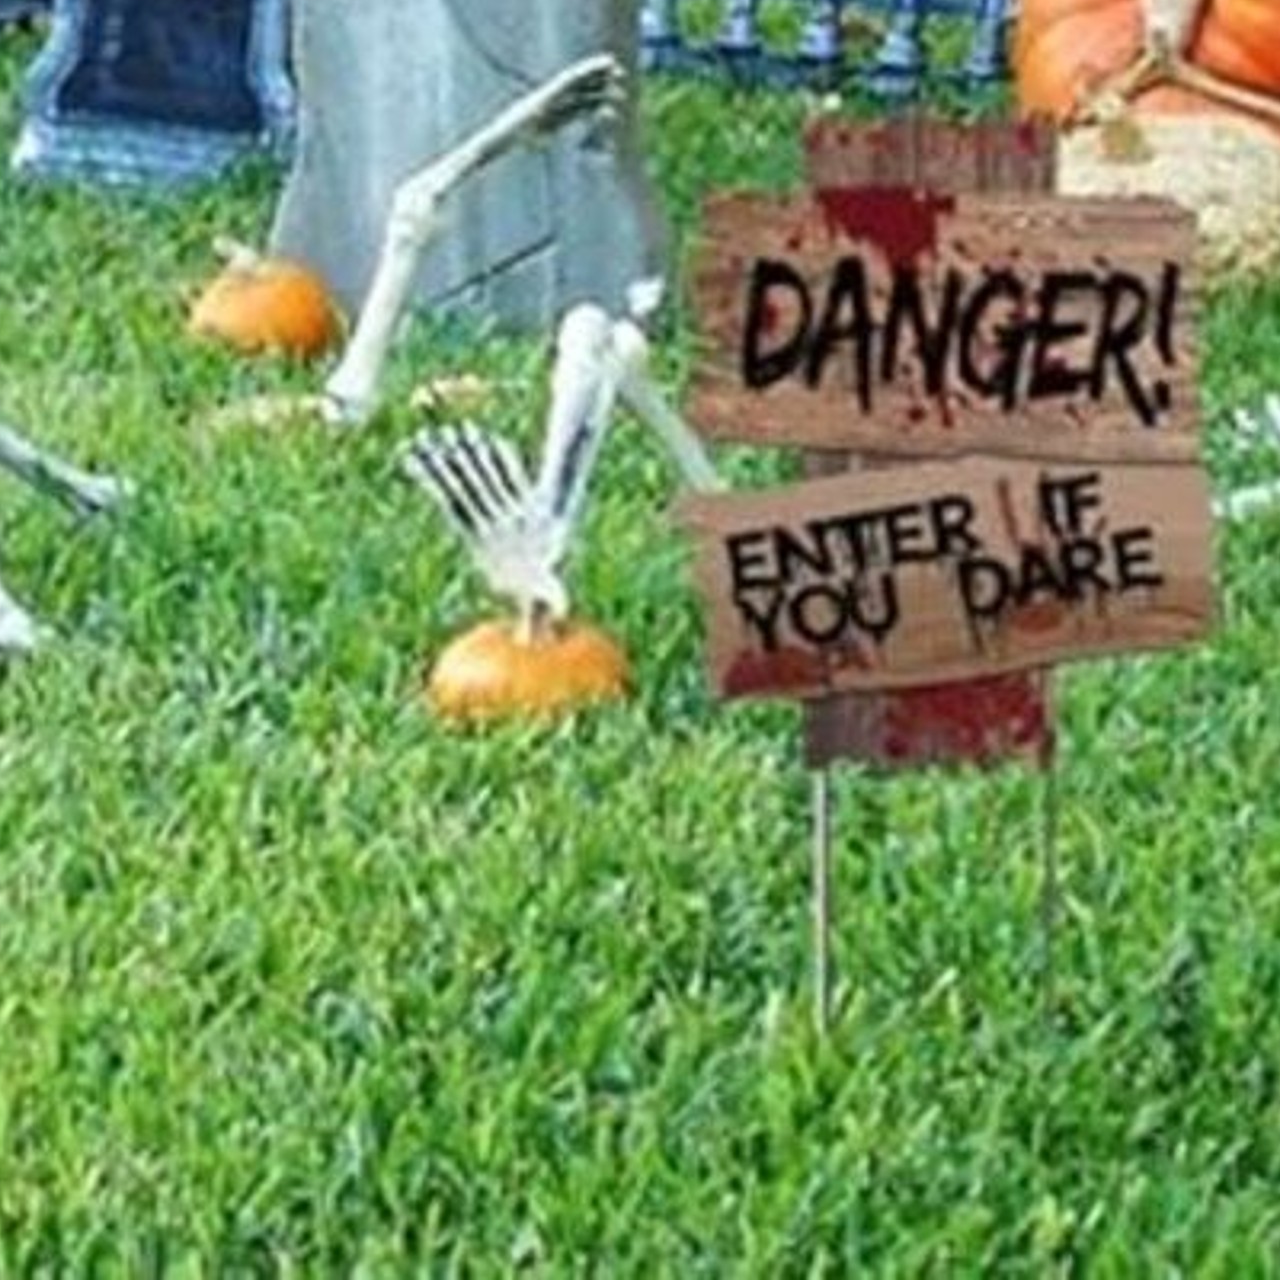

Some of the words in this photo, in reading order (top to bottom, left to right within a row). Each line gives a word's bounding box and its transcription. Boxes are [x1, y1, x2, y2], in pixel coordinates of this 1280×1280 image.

[741, 254, 1180, 427] DANGER!
[725, 494, 980, 592] ENTER
[1034, 472, 1102, 537] IF
[731, 568, 900, 653] YOU
[957, 527, 1162, 622] DARE
